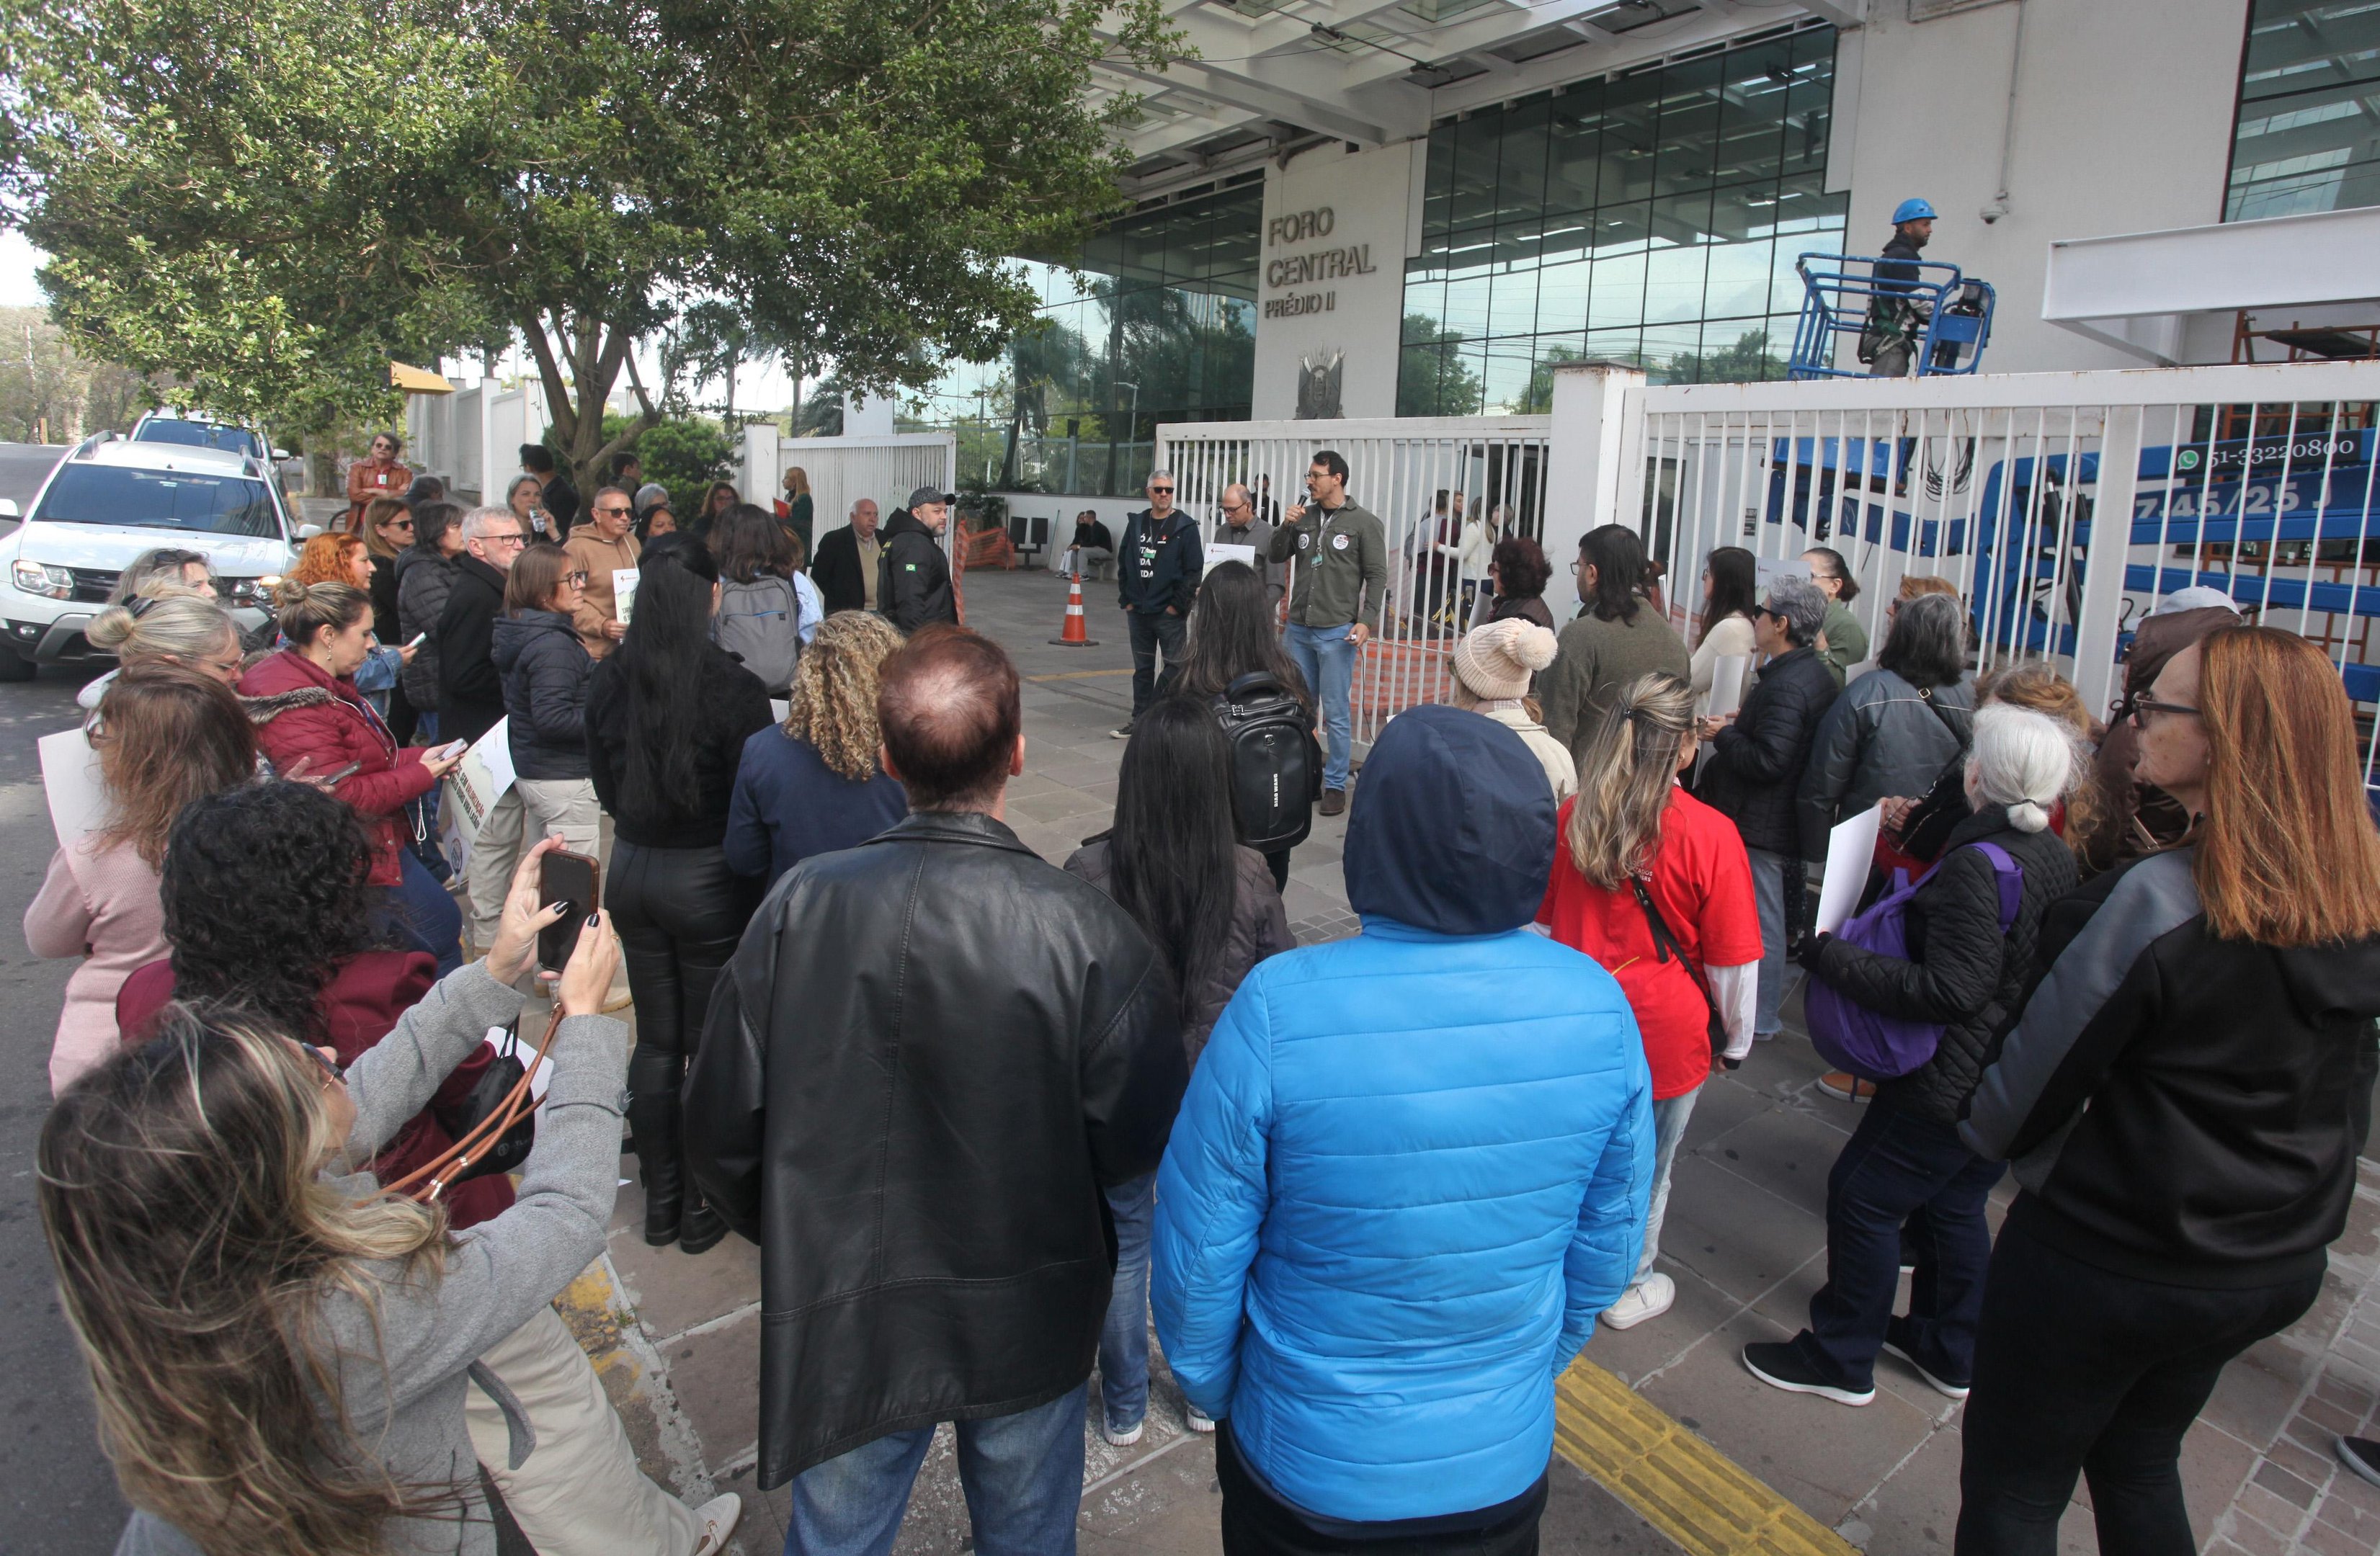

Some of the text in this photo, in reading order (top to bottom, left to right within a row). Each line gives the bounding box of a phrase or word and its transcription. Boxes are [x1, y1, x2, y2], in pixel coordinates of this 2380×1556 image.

[1268, 207, 1334, 246] FORO
[1266, 243, 1377, 288] CENTRAL
[1265, 290, 1336, 318] PRÉDIO II
[2210, 439, 2354, 468] 51-33220800
